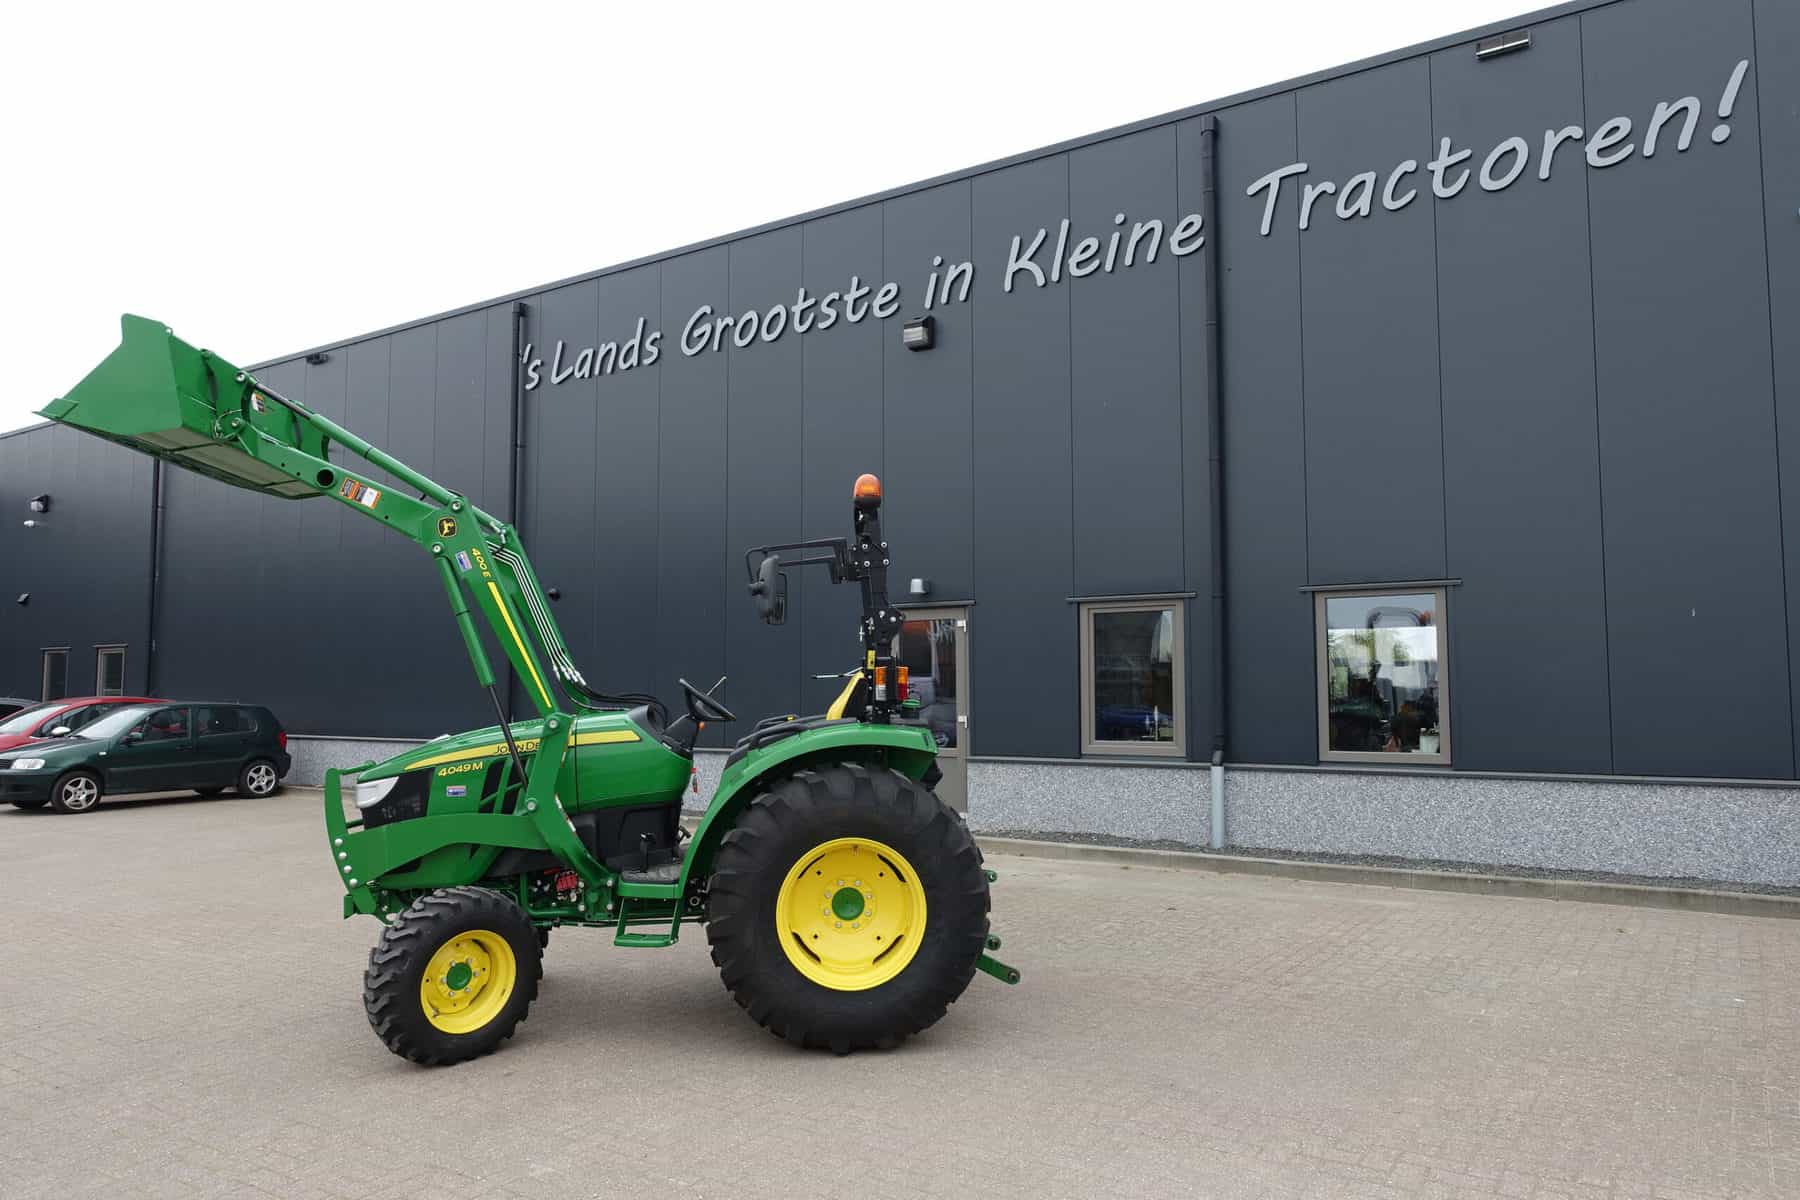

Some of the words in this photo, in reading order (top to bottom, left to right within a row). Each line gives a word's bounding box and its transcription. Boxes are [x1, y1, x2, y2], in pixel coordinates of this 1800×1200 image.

[550, 316, 662, 386] Lands
[680, 275, 899, 357] Grootste
[924, 255, 973, 310] in
[1003, 212, 1205, 292] Kleine
[1246, 59, 1749, 236] Tractoren!
[495, 743, 525, 754] JON
